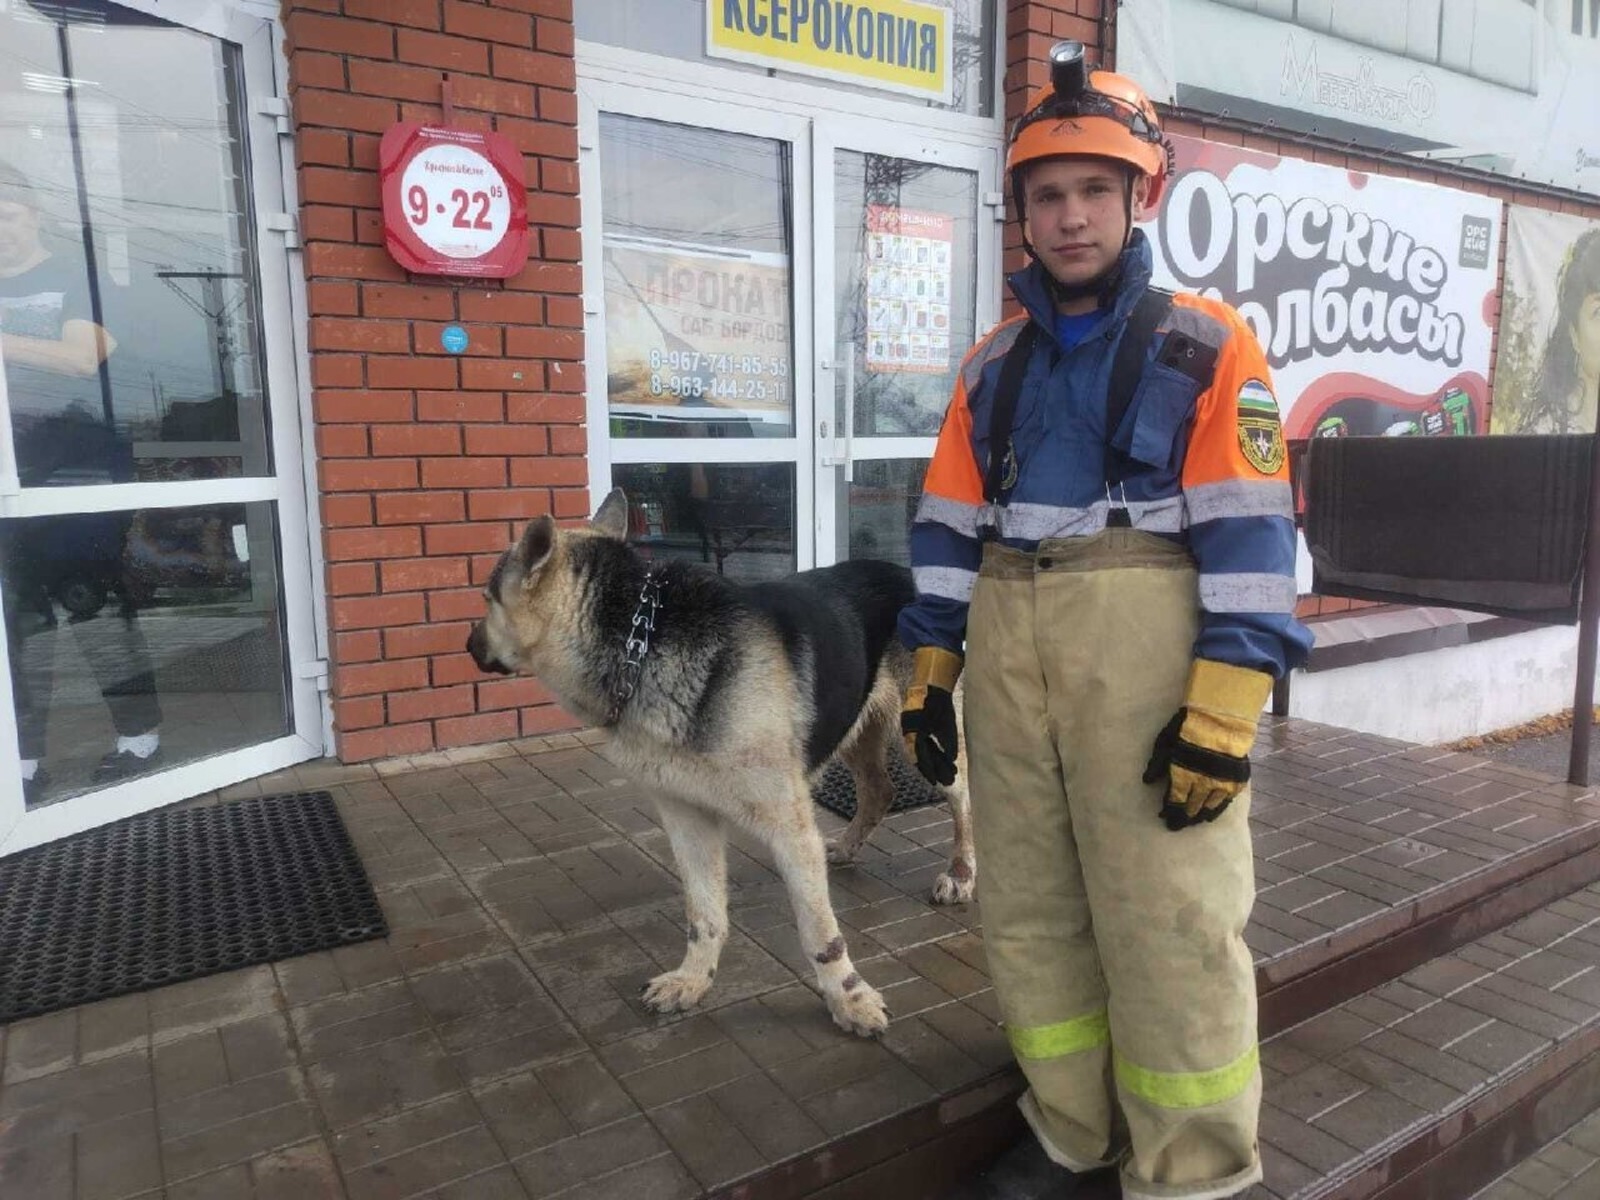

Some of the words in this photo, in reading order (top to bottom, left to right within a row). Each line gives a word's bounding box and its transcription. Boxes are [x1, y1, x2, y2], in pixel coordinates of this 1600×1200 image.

[723, 0, 937, 73] КСЕРОКОПИЯ
[1166, 170, 1447, 294] Орские
[646, 266, 787, 317] ПРОКАТ
[1202, 264, 1463, 360] олбасы
